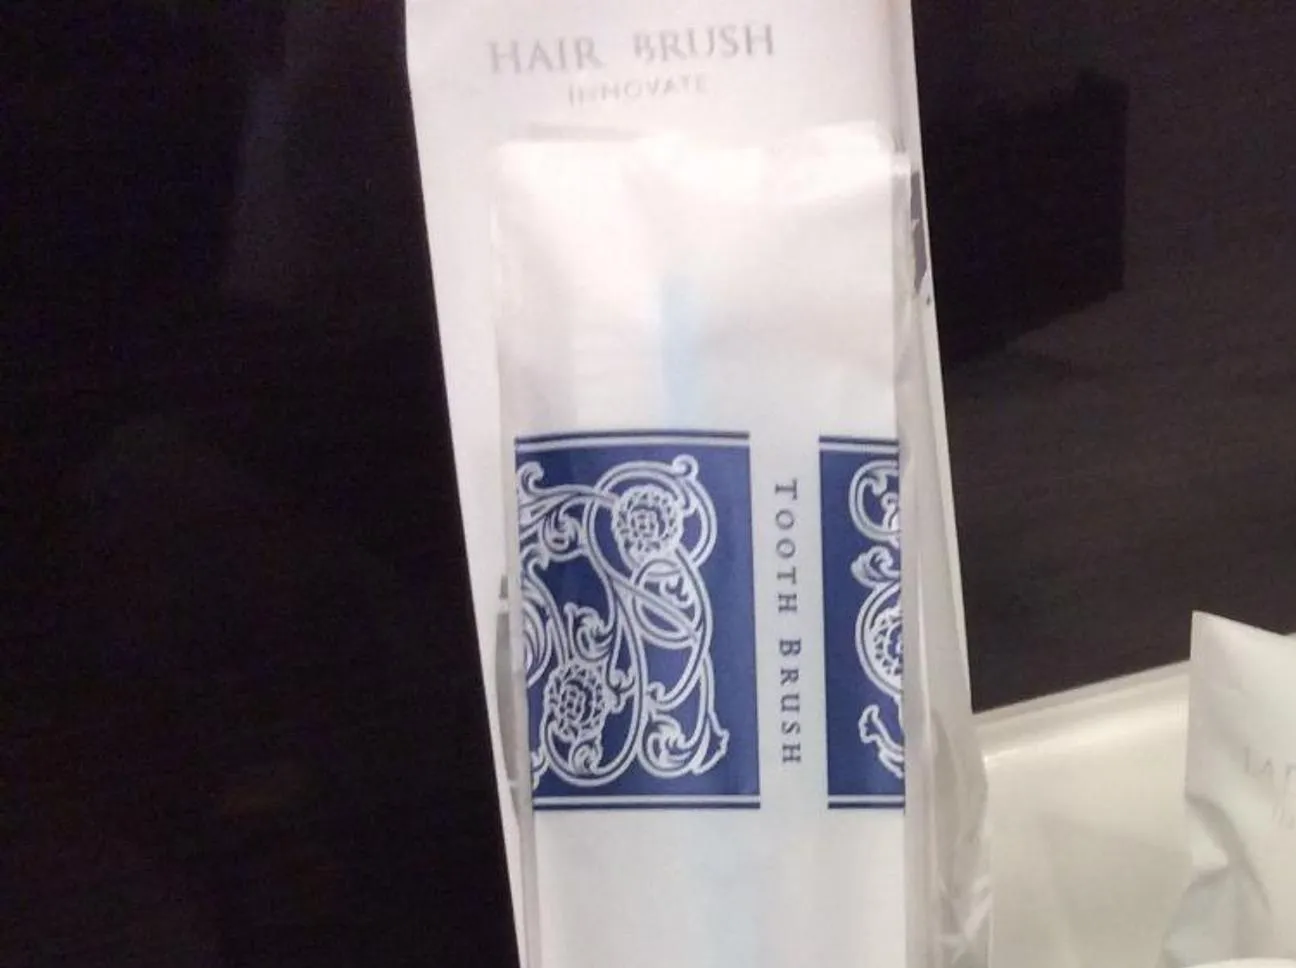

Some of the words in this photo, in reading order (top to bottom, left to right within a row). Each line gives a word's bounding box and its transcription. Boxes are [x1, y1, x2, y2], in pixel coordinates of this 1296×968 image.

[486, 34, 606, 75] HAIR
[632, 22, 774, 63] BRUSH
[774, 478, 799, 614] TOOTH
[778, 638, 803, 766] BRUSH
